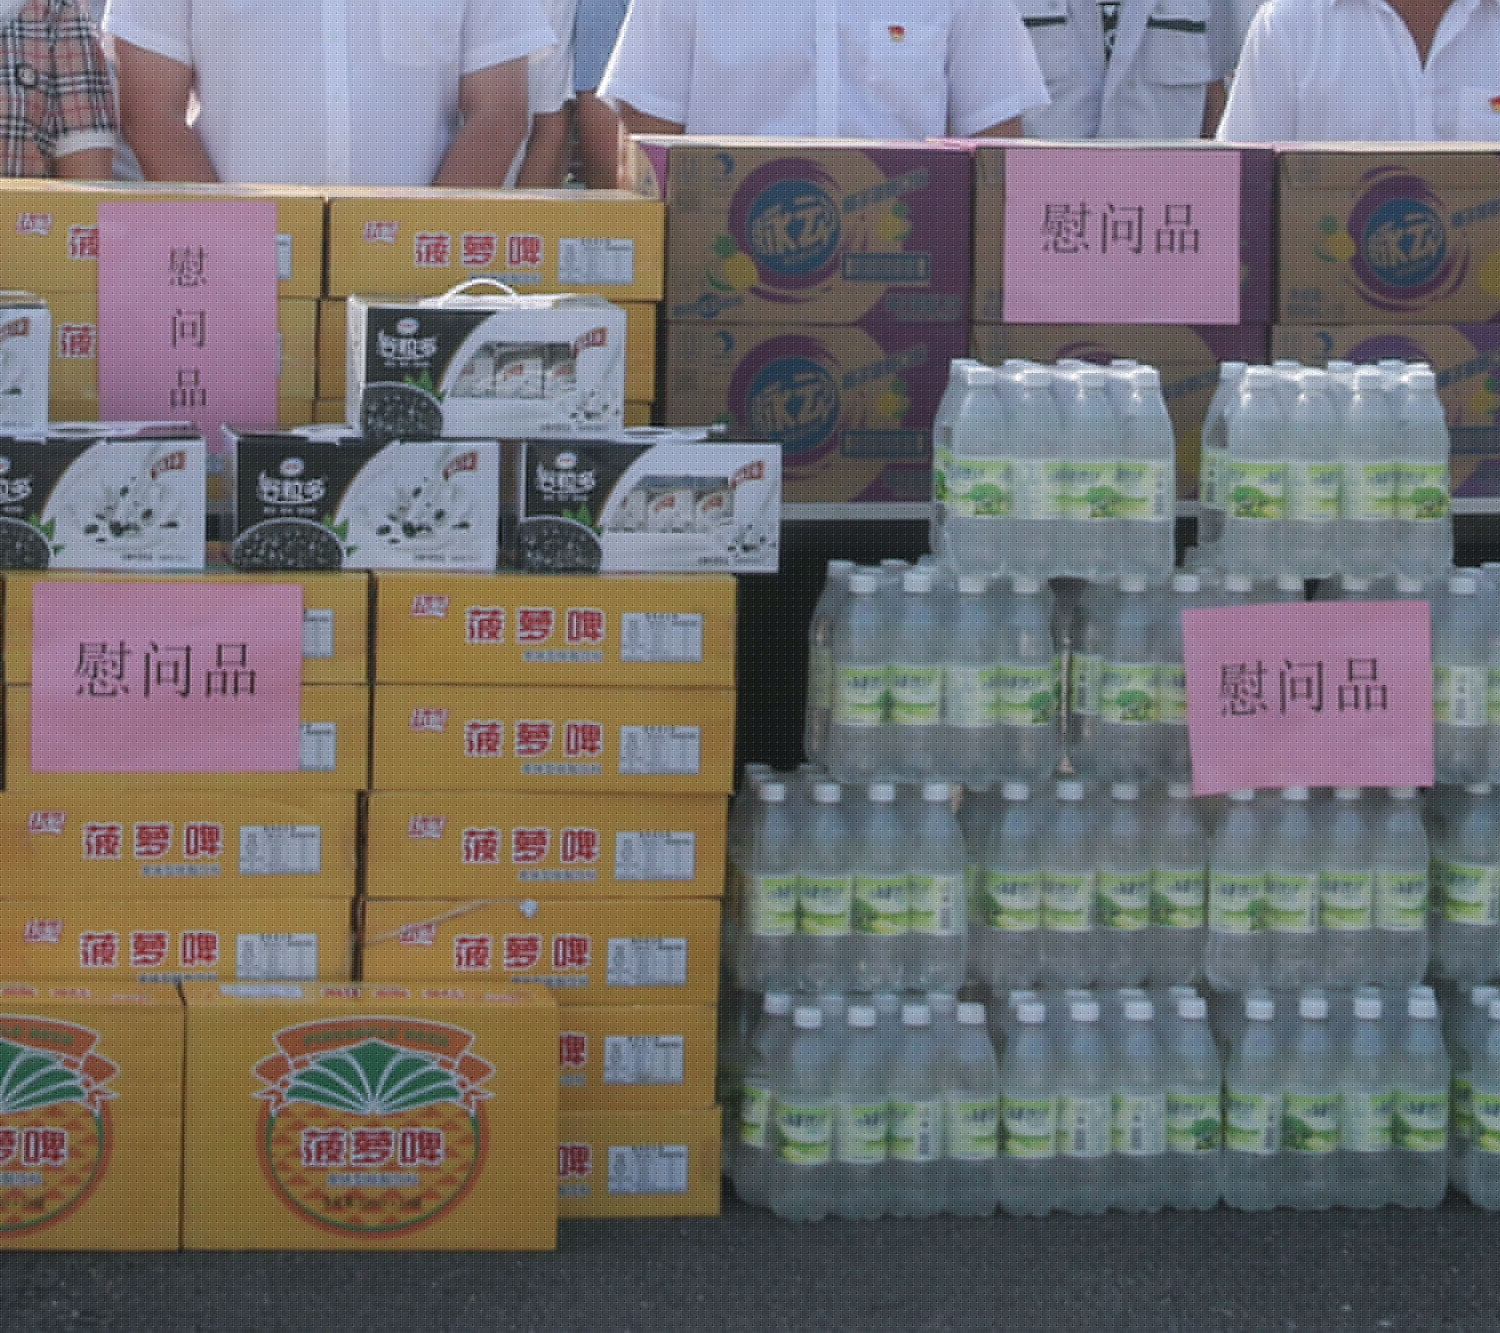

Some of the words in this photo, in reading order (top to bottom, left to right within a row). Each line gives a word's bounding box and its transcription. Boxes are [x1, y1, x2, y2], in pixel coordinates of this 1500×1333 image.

[1040, 201, 1201, 255] 慰问品
[414, 231, 544, 267] 菠萝啤
[168, 245, 209, 409] 慰问品
[465, 606, 605, 643] 菠萝啤
[73, 640, 258, 699] 慰问品
[1217, 656, 1391, 718] 慰问品
[463, 719, 603, 757] 菠萝啤
[84, 821, 223, 859] 菠萝啤
[461, 827, 600, 865] 菠萝啤
[80, 930, 220, 968] 菠萝啤
[453, 933, 591, 970] 菠萝啤
[299, 1128, 444, 1166] 菠萝啤
